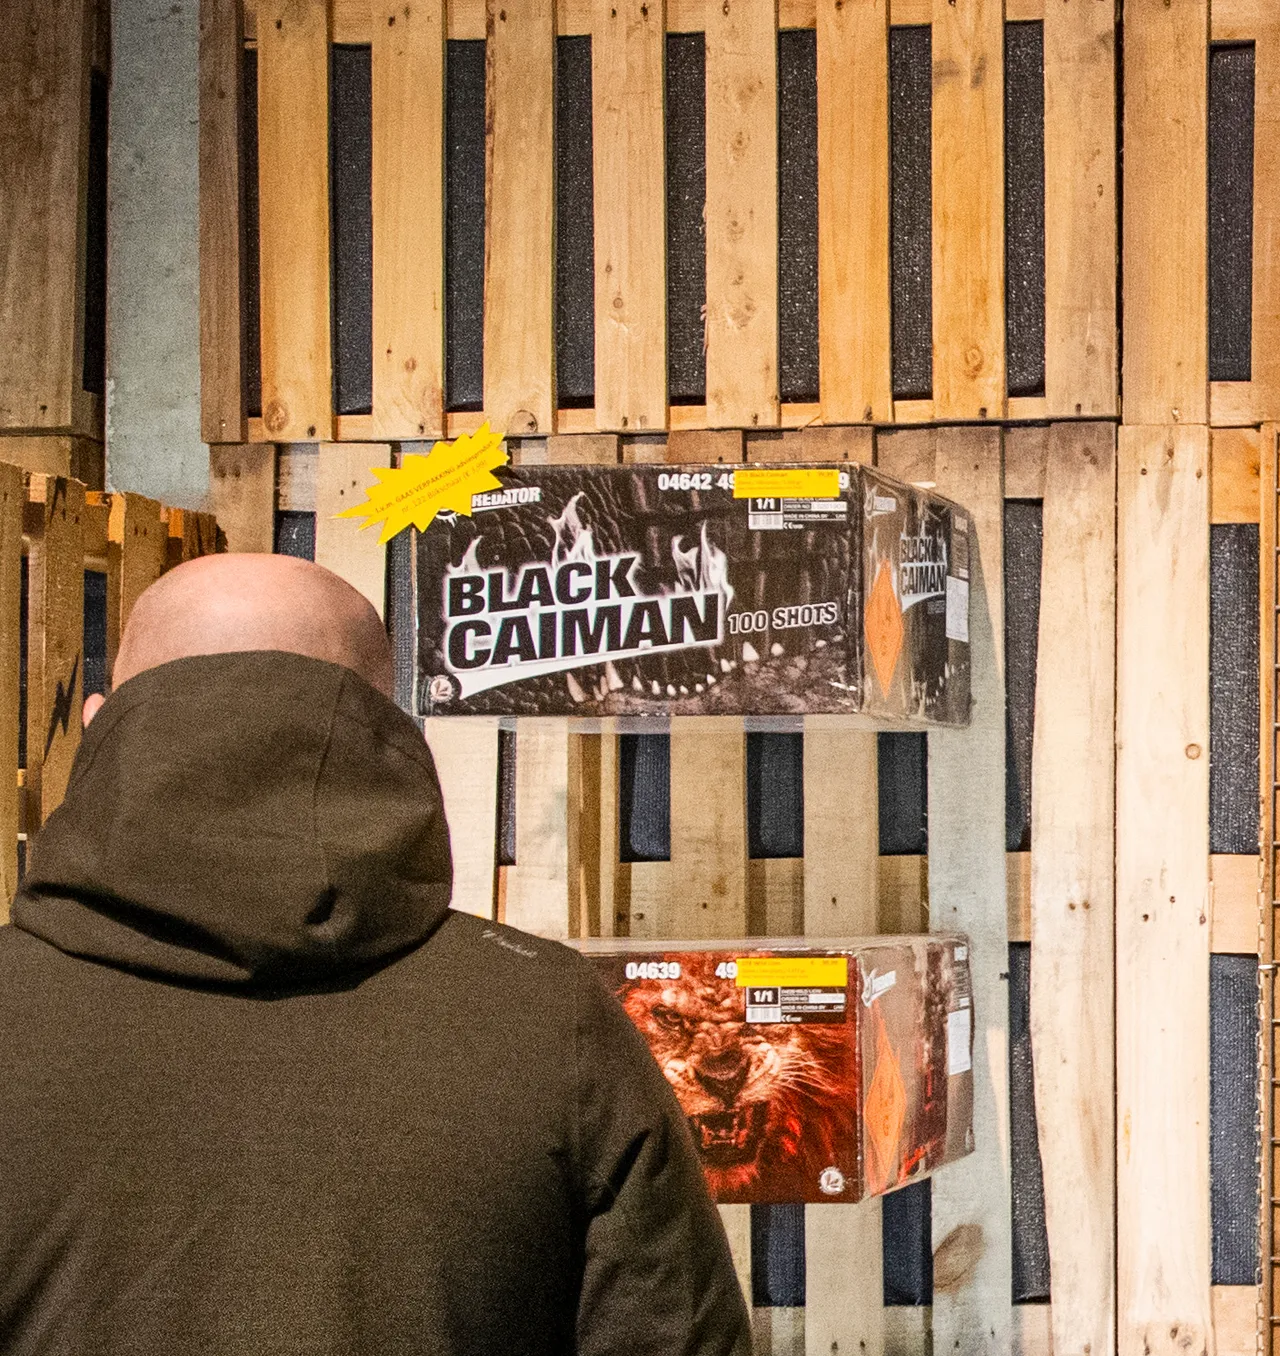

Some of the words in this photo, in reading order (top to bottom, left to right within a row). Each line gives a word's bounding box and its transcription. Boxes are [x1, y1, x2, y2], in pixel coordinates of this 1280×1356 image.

[414, 467, 456, 493] VERPAKKING
[658, 473, 712, 491] 04642
[471, 486, 542, 507] REDATOR
[448, 556, 636, 618] BLACK
[901, 565, 947, 596] CAIMAN
[728, 611, 768, 635] 100
[771, 602, 838, 631] SHOTS
[448, 594, 720, 670] CAIMAN
[625, 961, 681, 980] 04639
[753, 990, 773, 1003] 1/1
